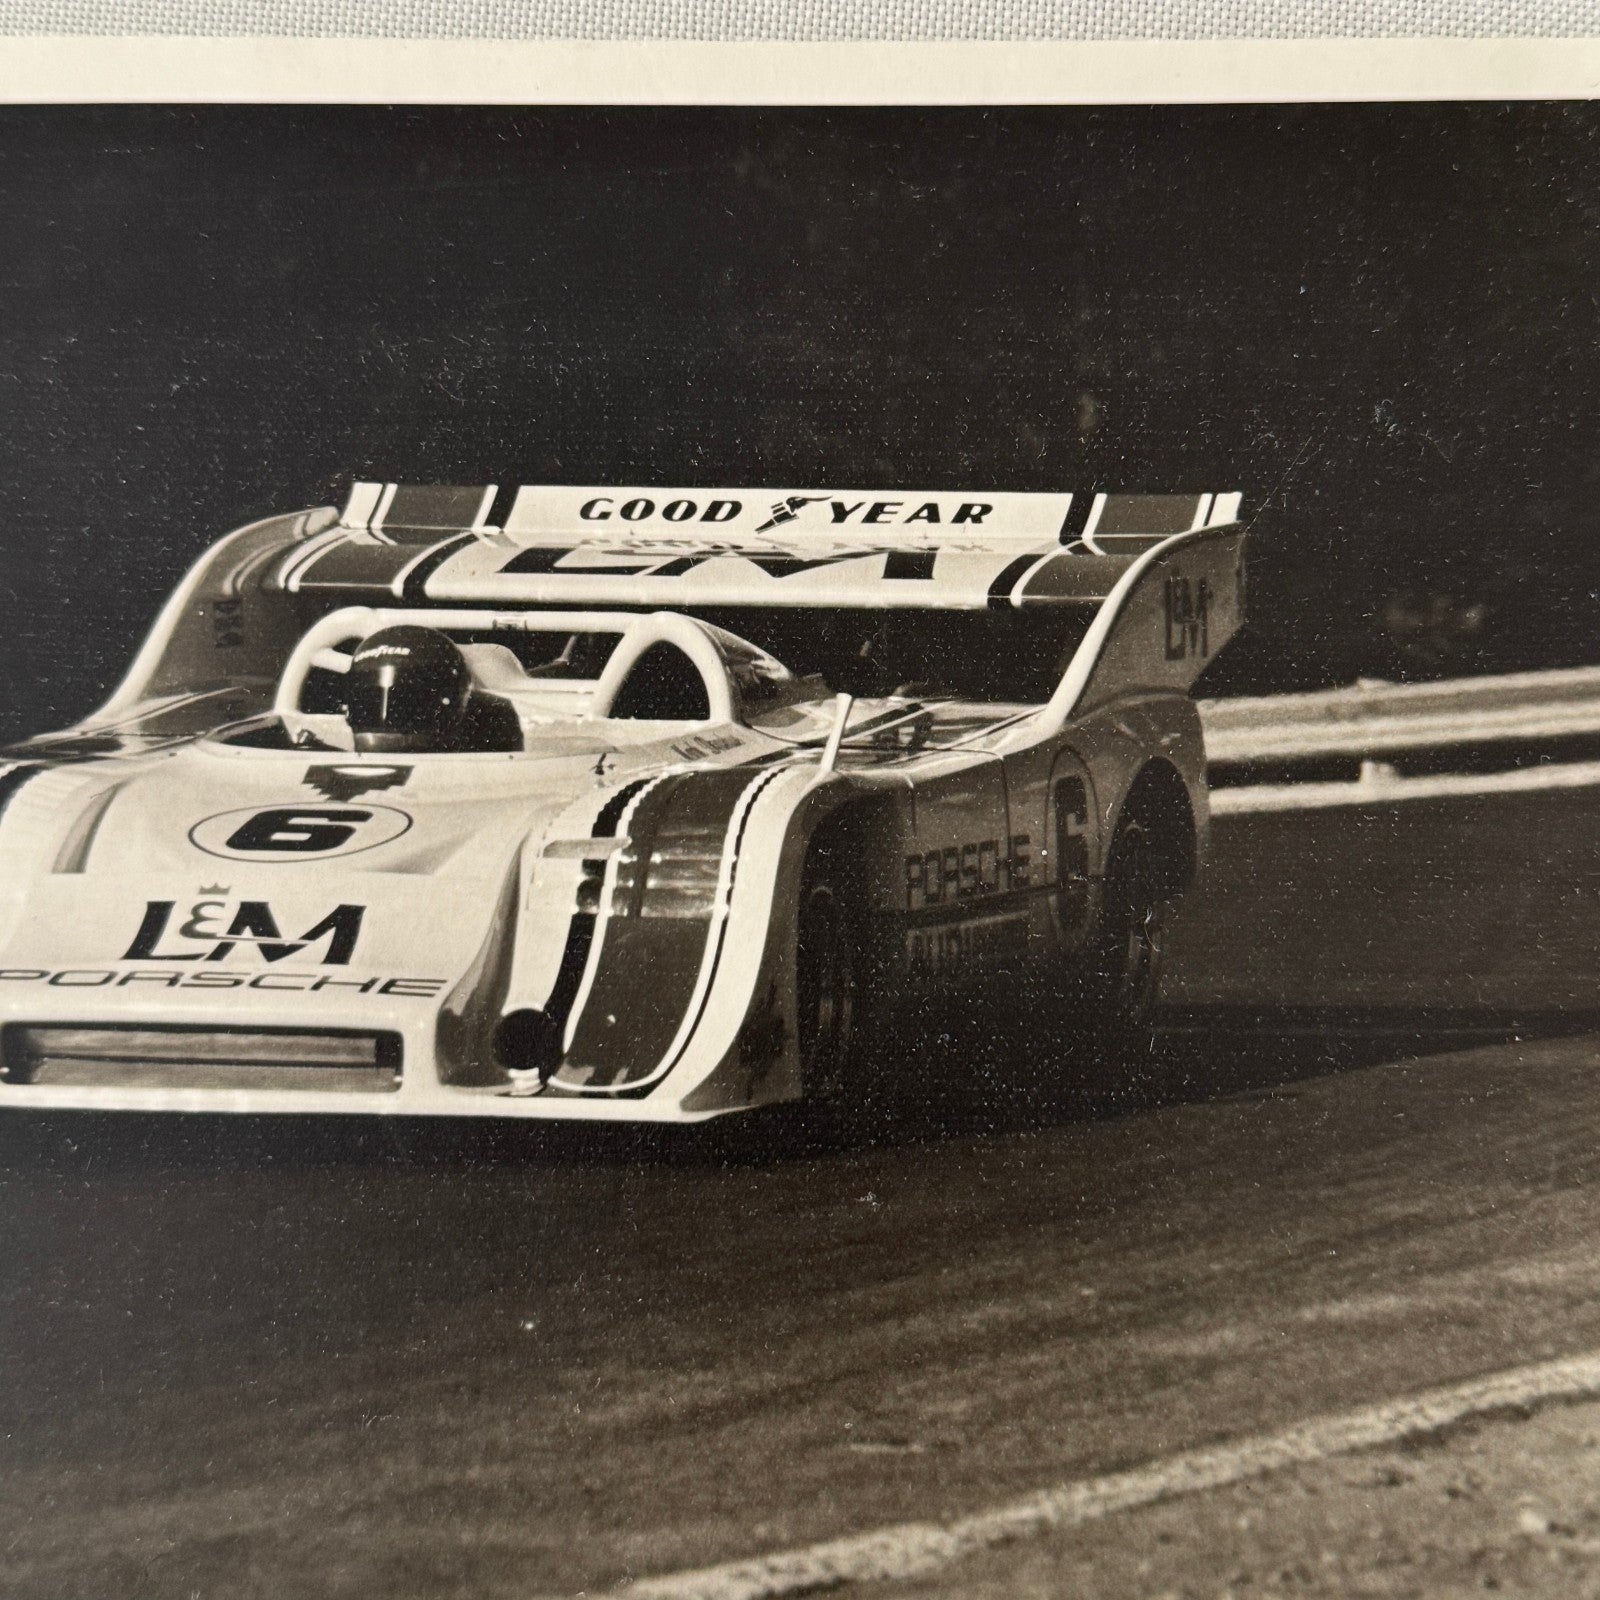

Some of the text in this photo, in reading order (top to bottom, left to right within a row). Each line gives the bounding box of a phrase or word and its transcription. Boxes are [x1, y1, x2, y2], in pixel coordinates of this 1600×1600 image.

[580, 498, 993, 524] GOOD YEAR
[226, 809, 374, 851] 6
[905, 835, 1031, 909] PORSCHE
[120, 901, 367, 965] L&M
[0, 969, 448, 998] PORSCHE
